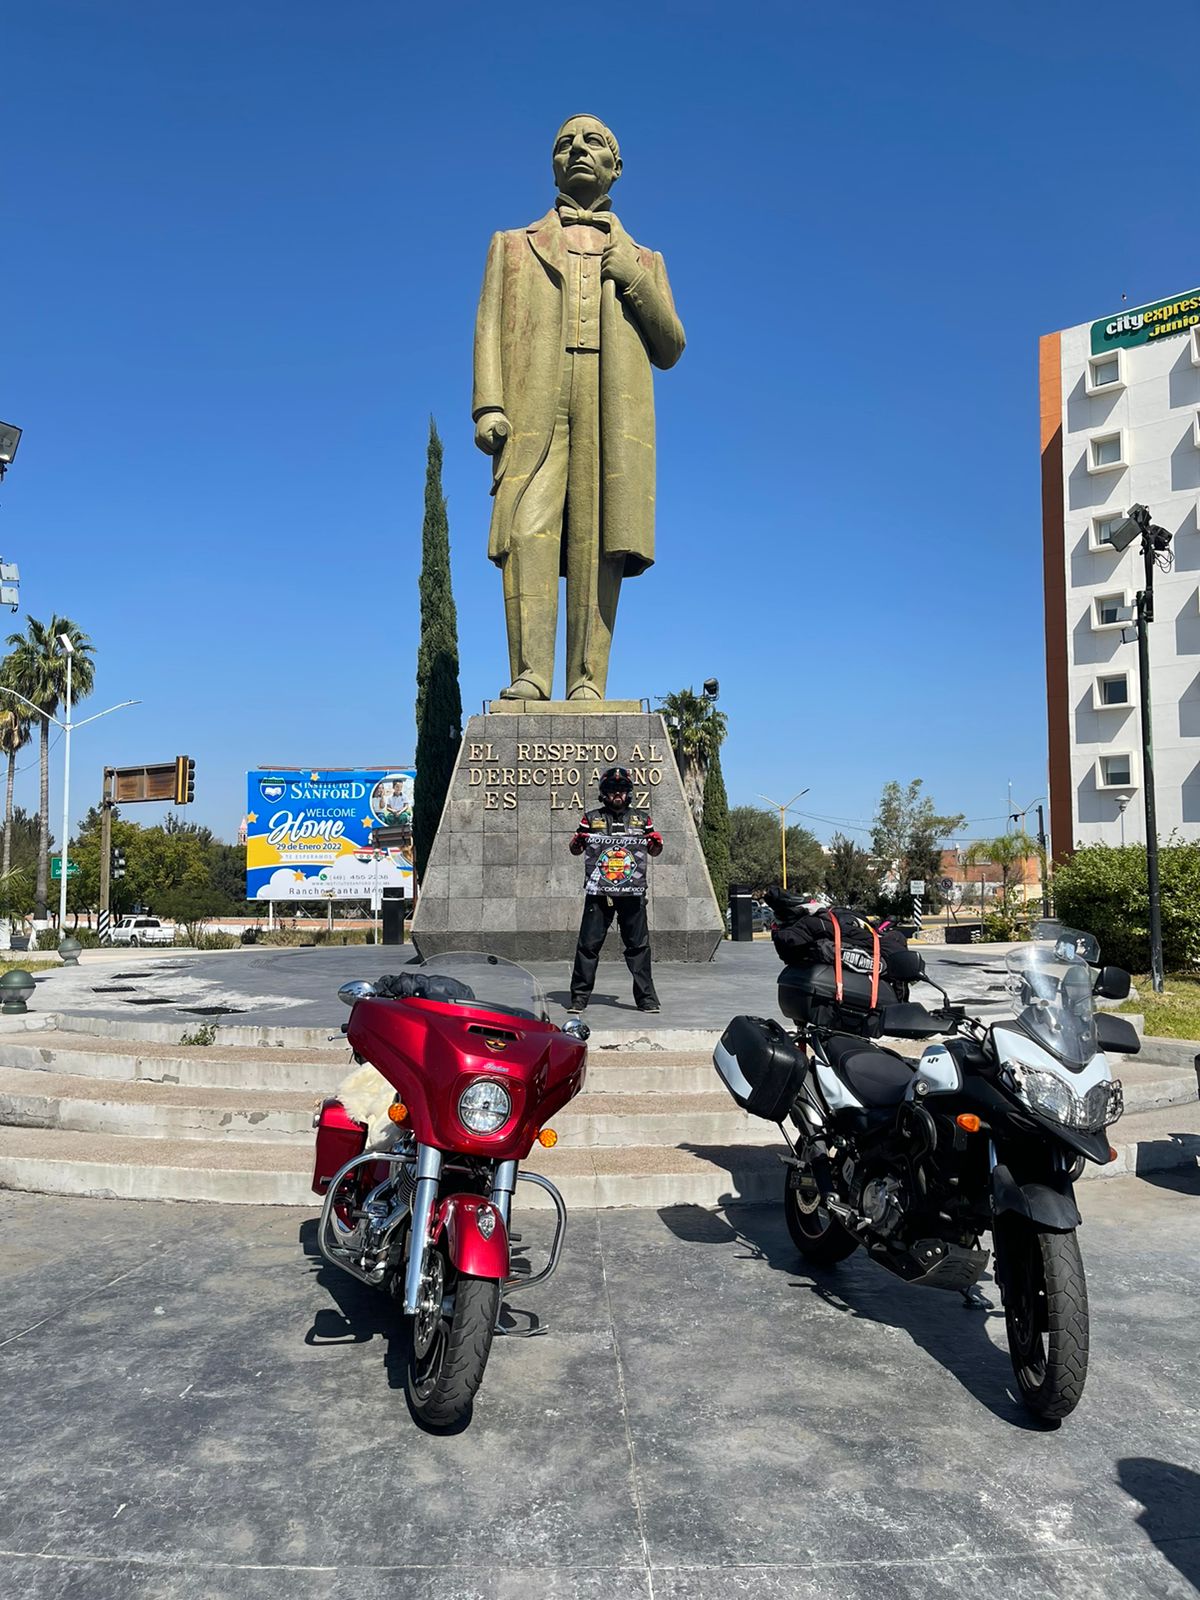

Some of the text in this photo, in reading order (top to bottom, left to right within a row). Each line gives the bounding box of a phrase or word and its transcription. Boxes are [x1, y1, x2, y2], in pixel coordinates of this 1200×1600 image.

[1149, 315, 1200, 337] junio
[468, 743, 662, 762] EL RESPETO AL
[468, 767, 662, 785] DERECHO ANO
[290, 782, 365, 799] SANFORD
[485, 791, 584, 809] ES LA
[305, 808, 356, 817] WELCOME
[268, 810, 345, 845] Home
